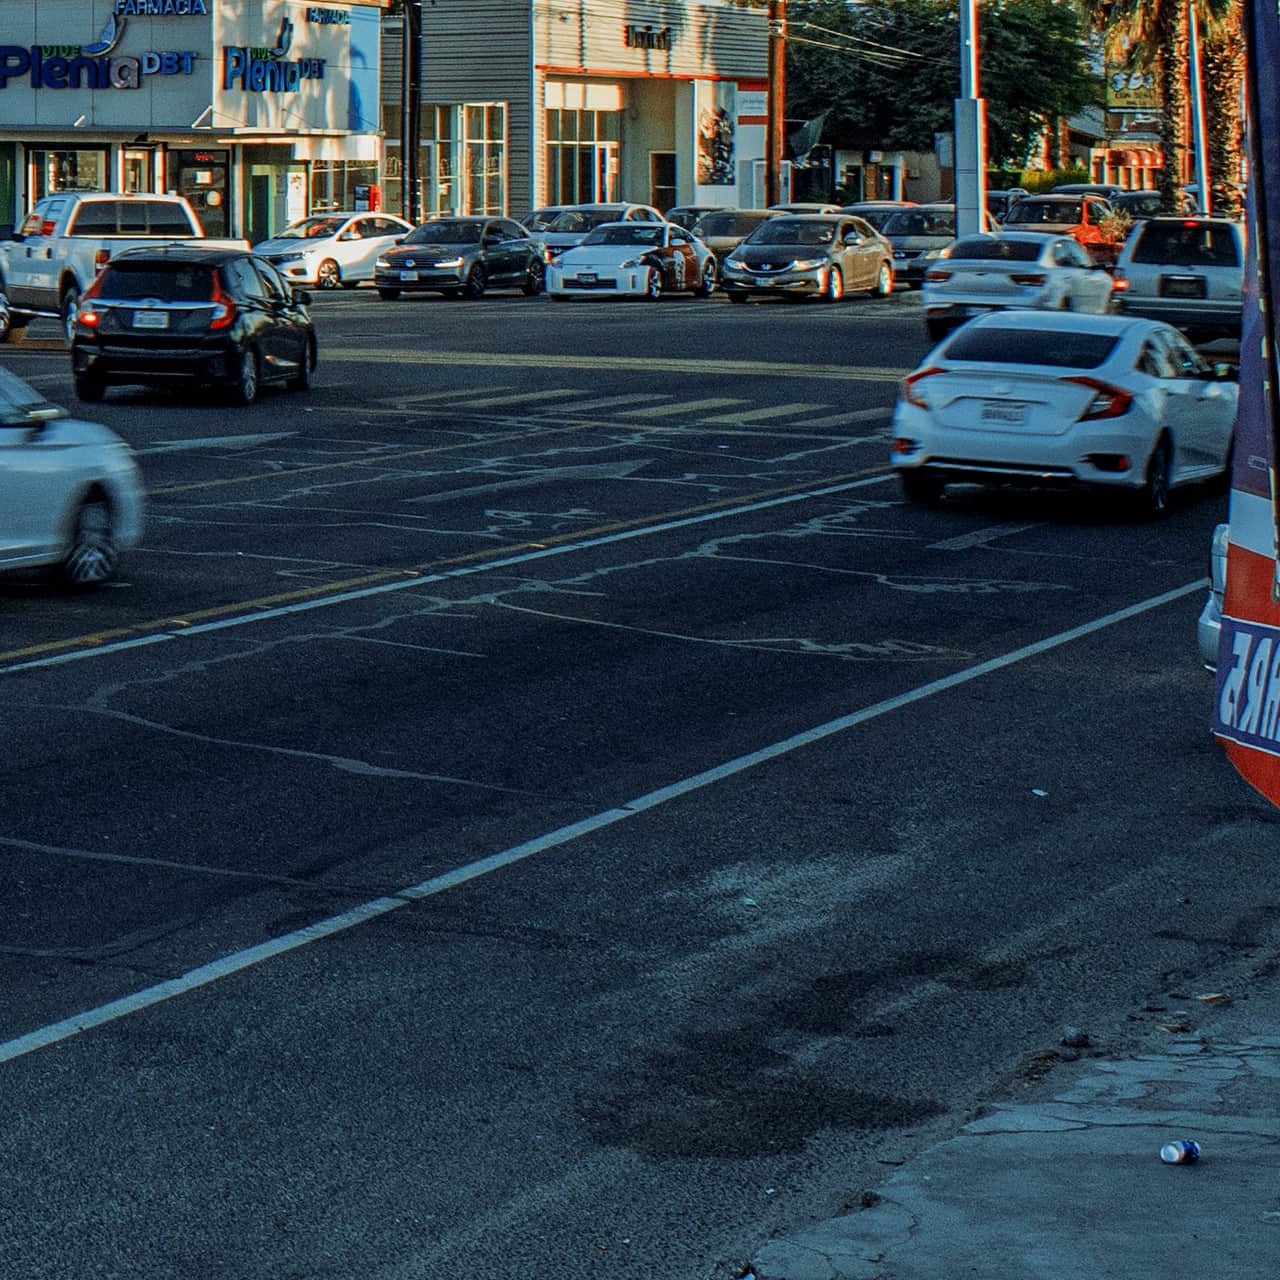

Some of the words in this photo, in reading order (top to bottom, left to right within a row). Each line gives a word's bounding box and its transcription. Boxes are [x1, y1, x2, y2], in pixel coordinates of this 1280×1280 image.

[42, 45, 81, 57] VIVE
[142, 51, 197, 75] DBT
[222, 46, 300, 92] Plenia
